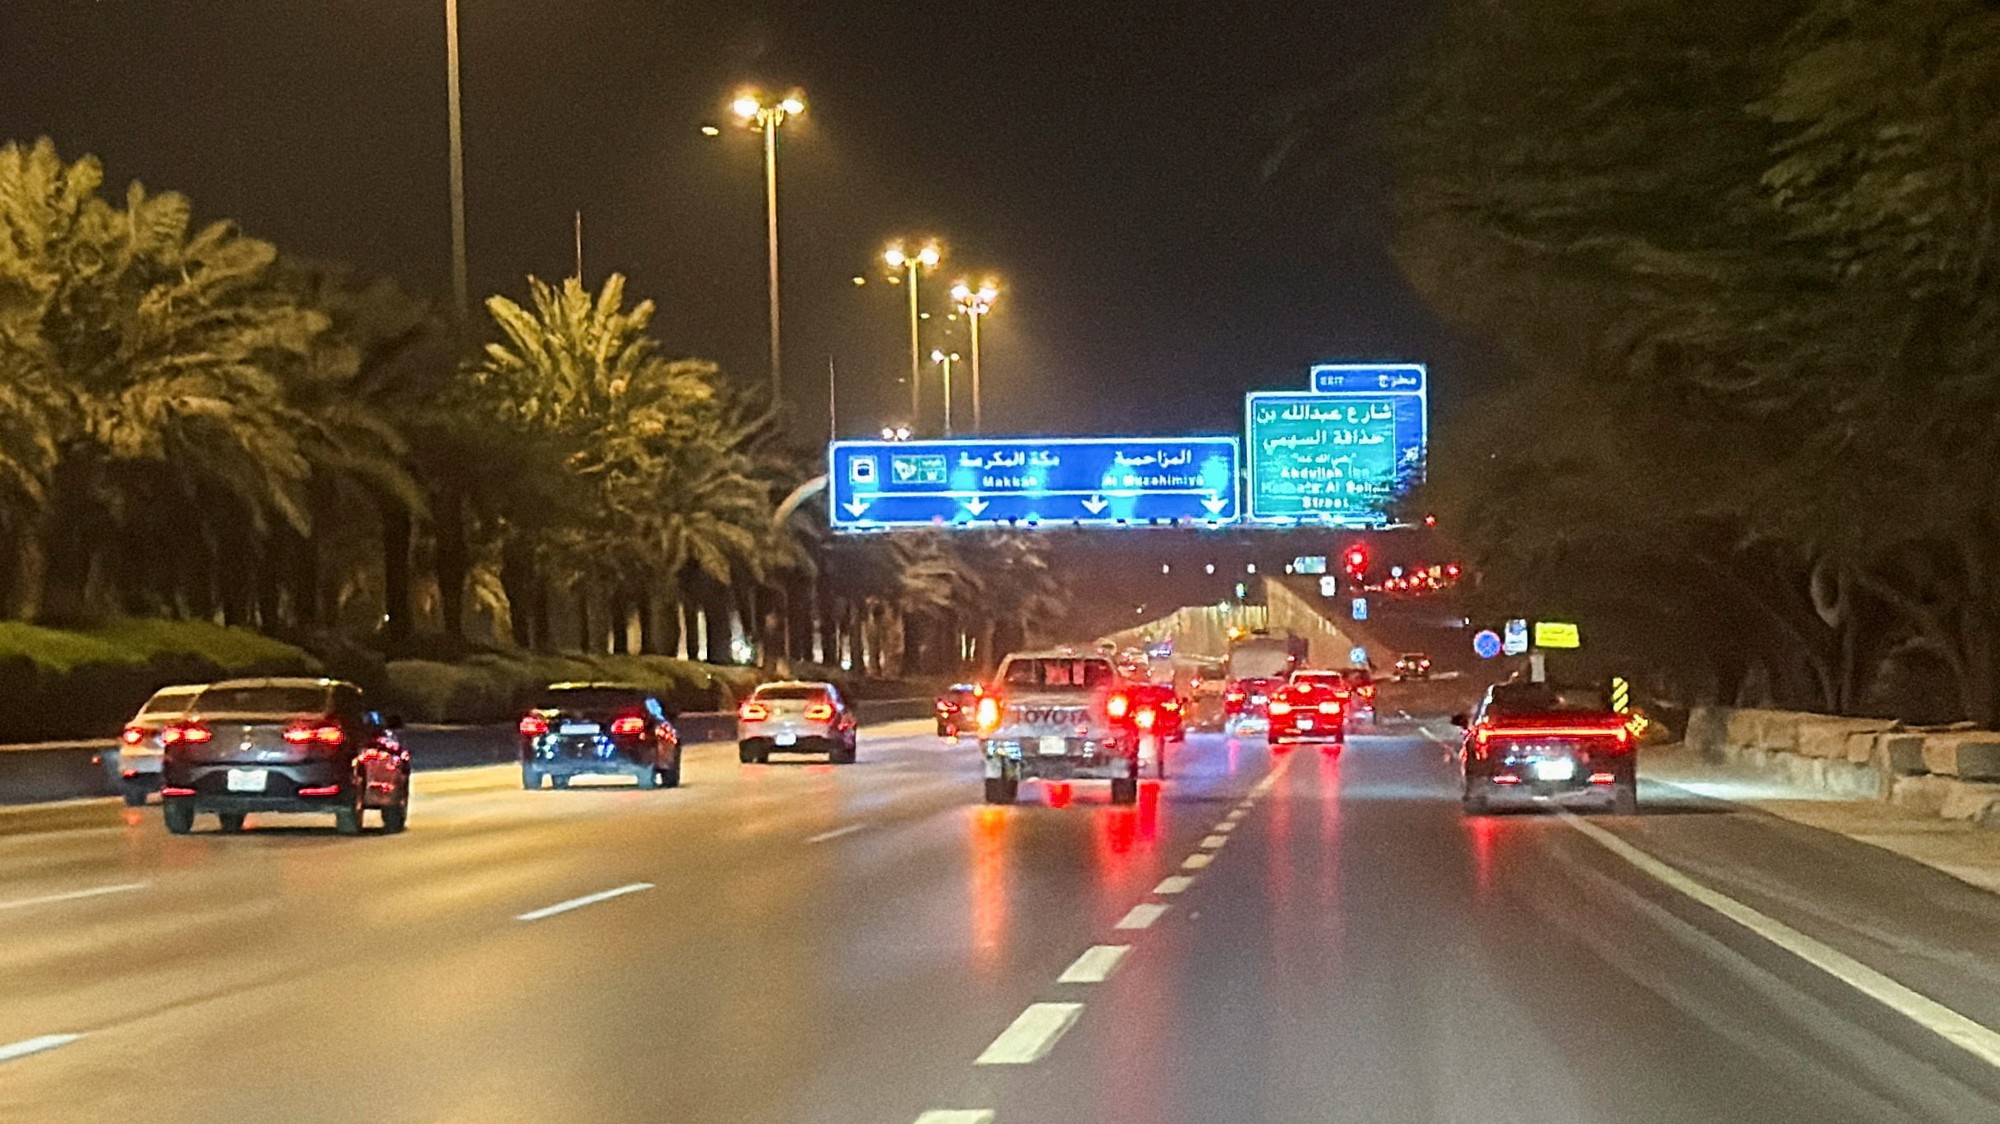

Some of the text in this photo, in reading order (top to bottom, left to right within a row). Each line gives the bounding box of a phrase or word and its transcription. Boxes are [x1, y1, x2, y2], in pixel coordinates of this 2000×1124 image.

[1320, 376, 1344, 386] EXIT
[1257, 403, 1392, 424] شارع عبدالله بن
[1030, 450, 1060, 466] مكة
[1113, 449, 1192, 468] المزاحمية
[1302, 496, 1350, 508] Street
[1016, 708, 1092, 724] TOYOTA
